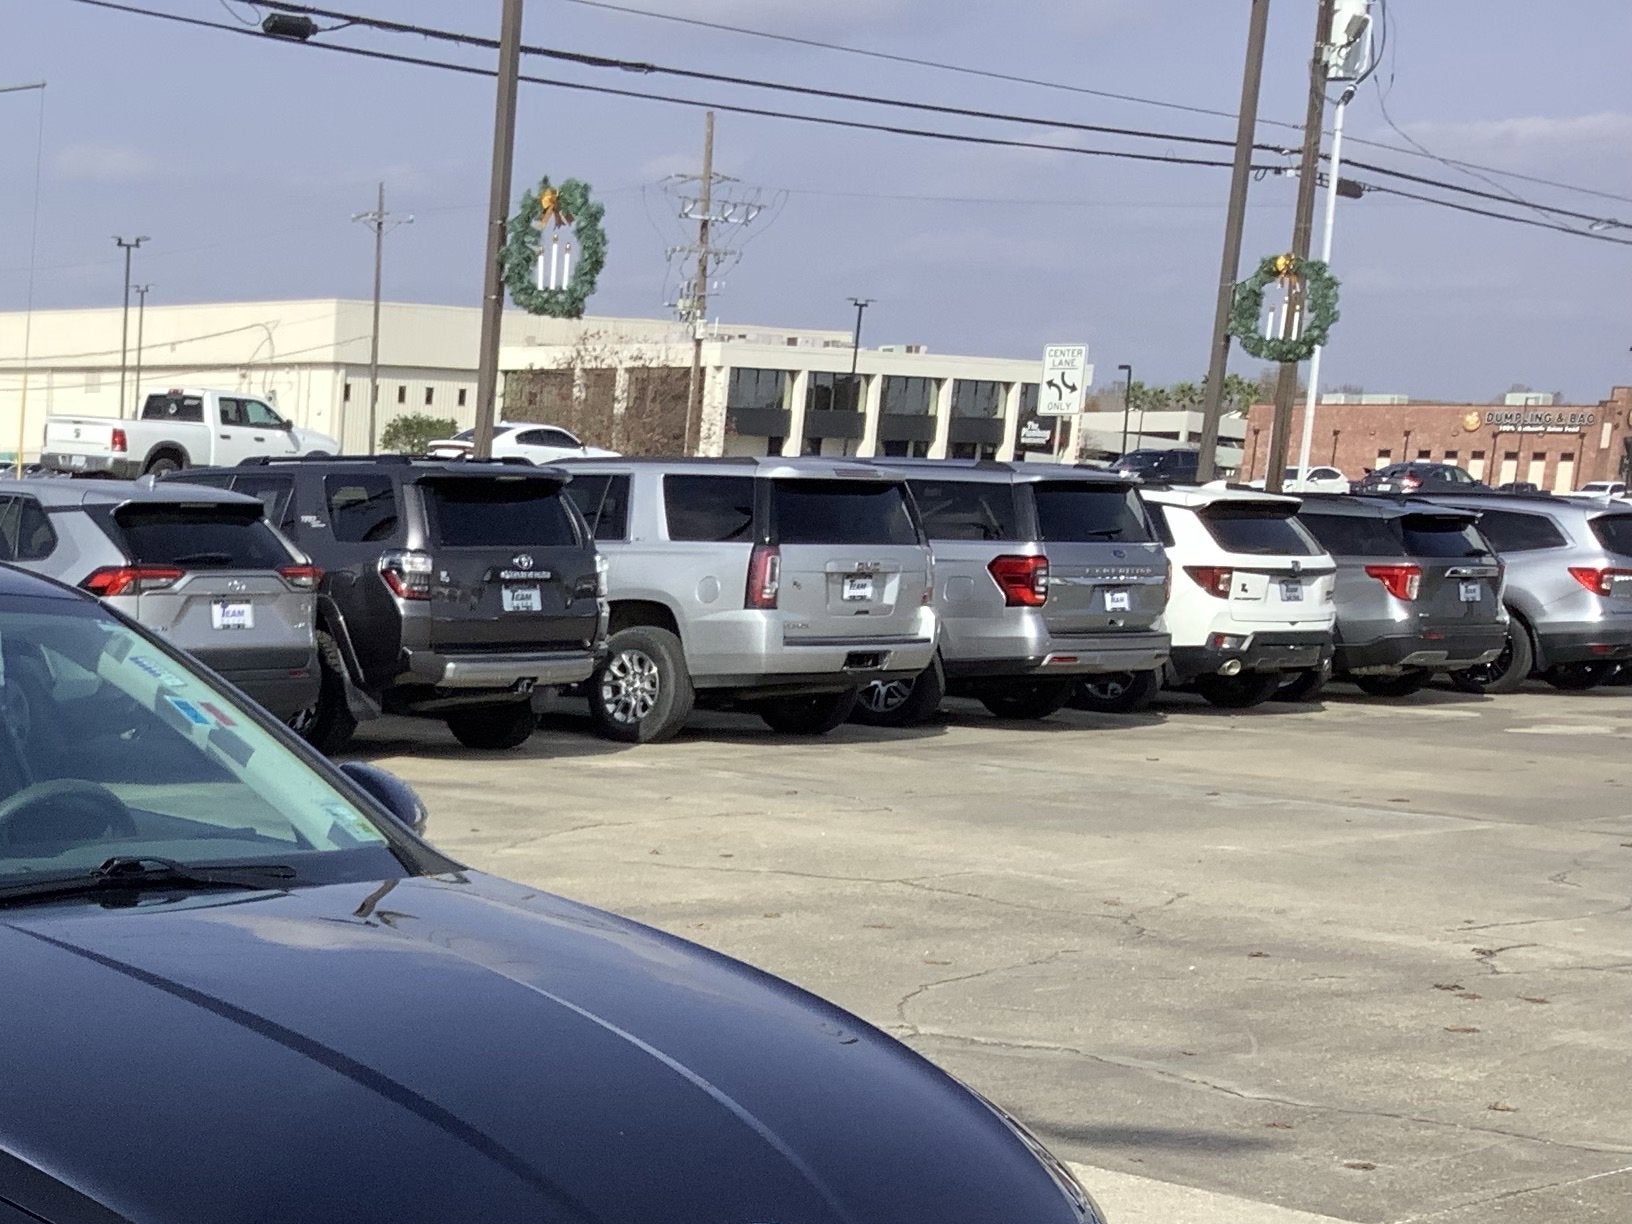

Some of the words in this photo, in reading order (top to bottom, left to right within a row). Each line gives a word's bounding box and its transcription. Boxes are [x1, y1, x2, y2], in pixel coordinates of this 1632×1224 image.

[1048, 348, 1083, 358] CENTER
[1052, 359, 1076, 367] LANE
[1047, 402, 1072, 411] ONLY
[1556, 412, 1564, 424] &
[1569, 412, 1595, 424] BAO
